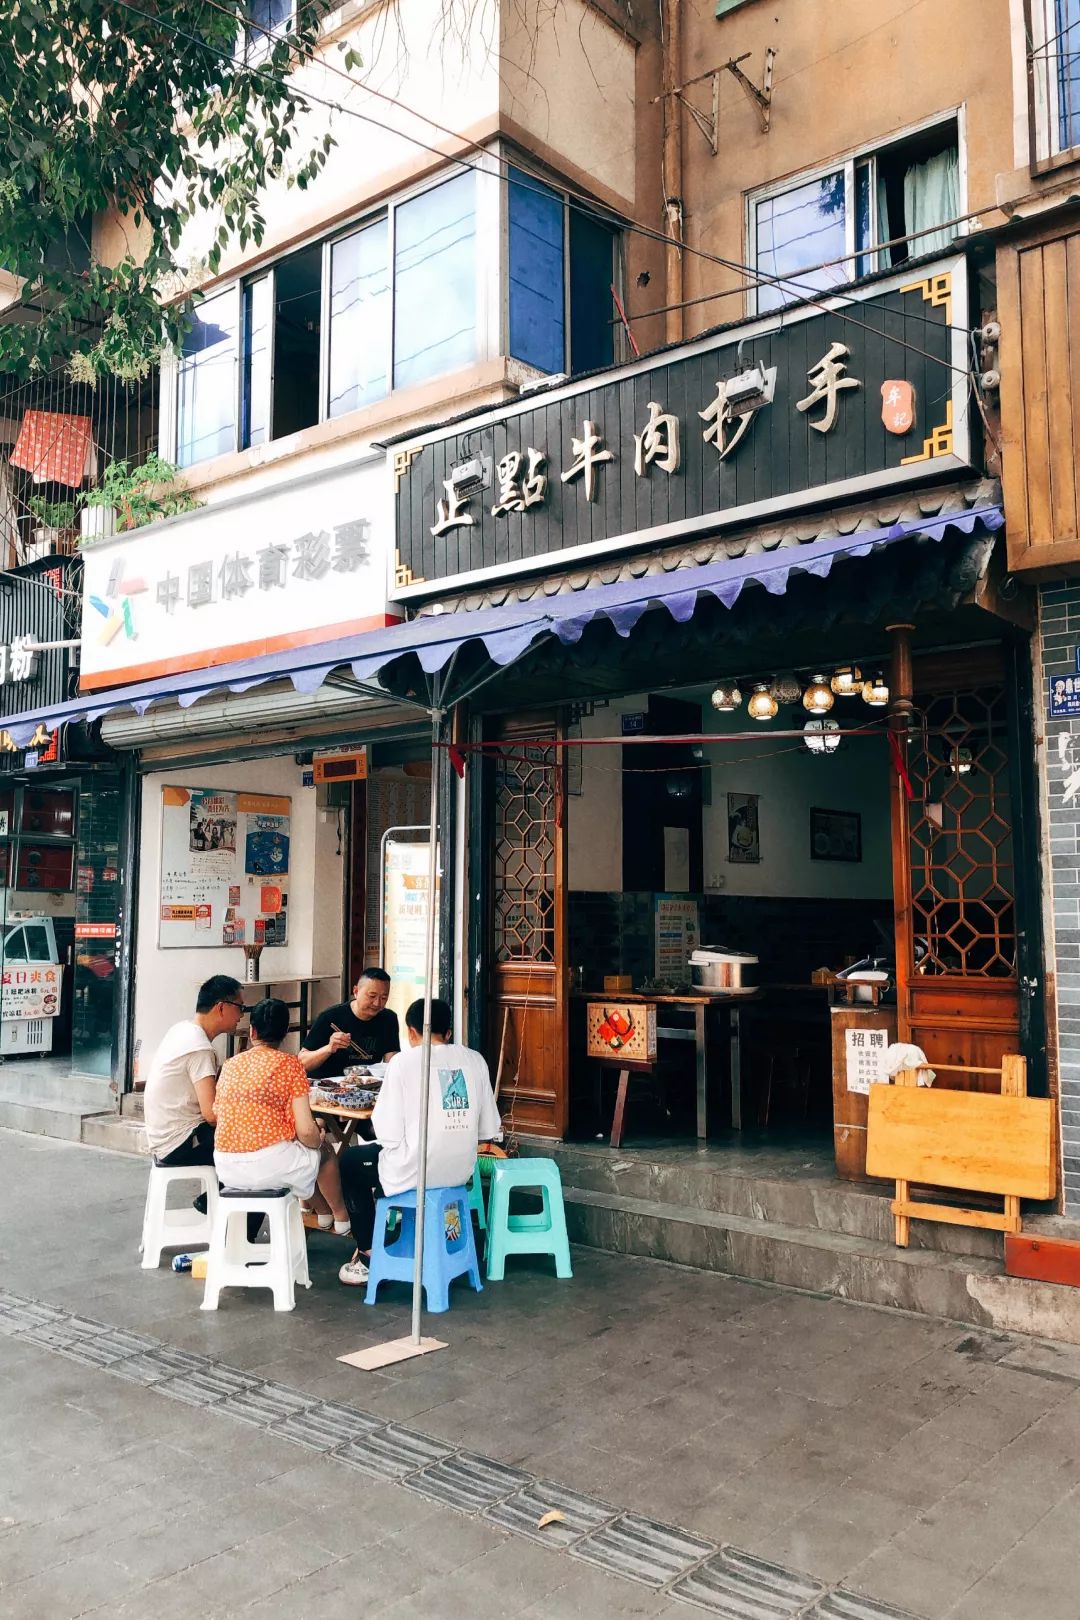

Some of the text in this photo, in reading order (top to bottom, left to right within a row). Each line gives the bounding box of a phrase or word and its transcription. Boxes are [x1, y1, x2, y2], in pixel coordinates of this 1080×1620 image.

[155, 517, 372, 615] 中国体育彩票
[0, 632, 35, 686] 粉
[852, 1032, 884, 1049] 招聘
[445, 1096, 467, 1109] SURF
[447, 1110, 467, 1118] LIFE
